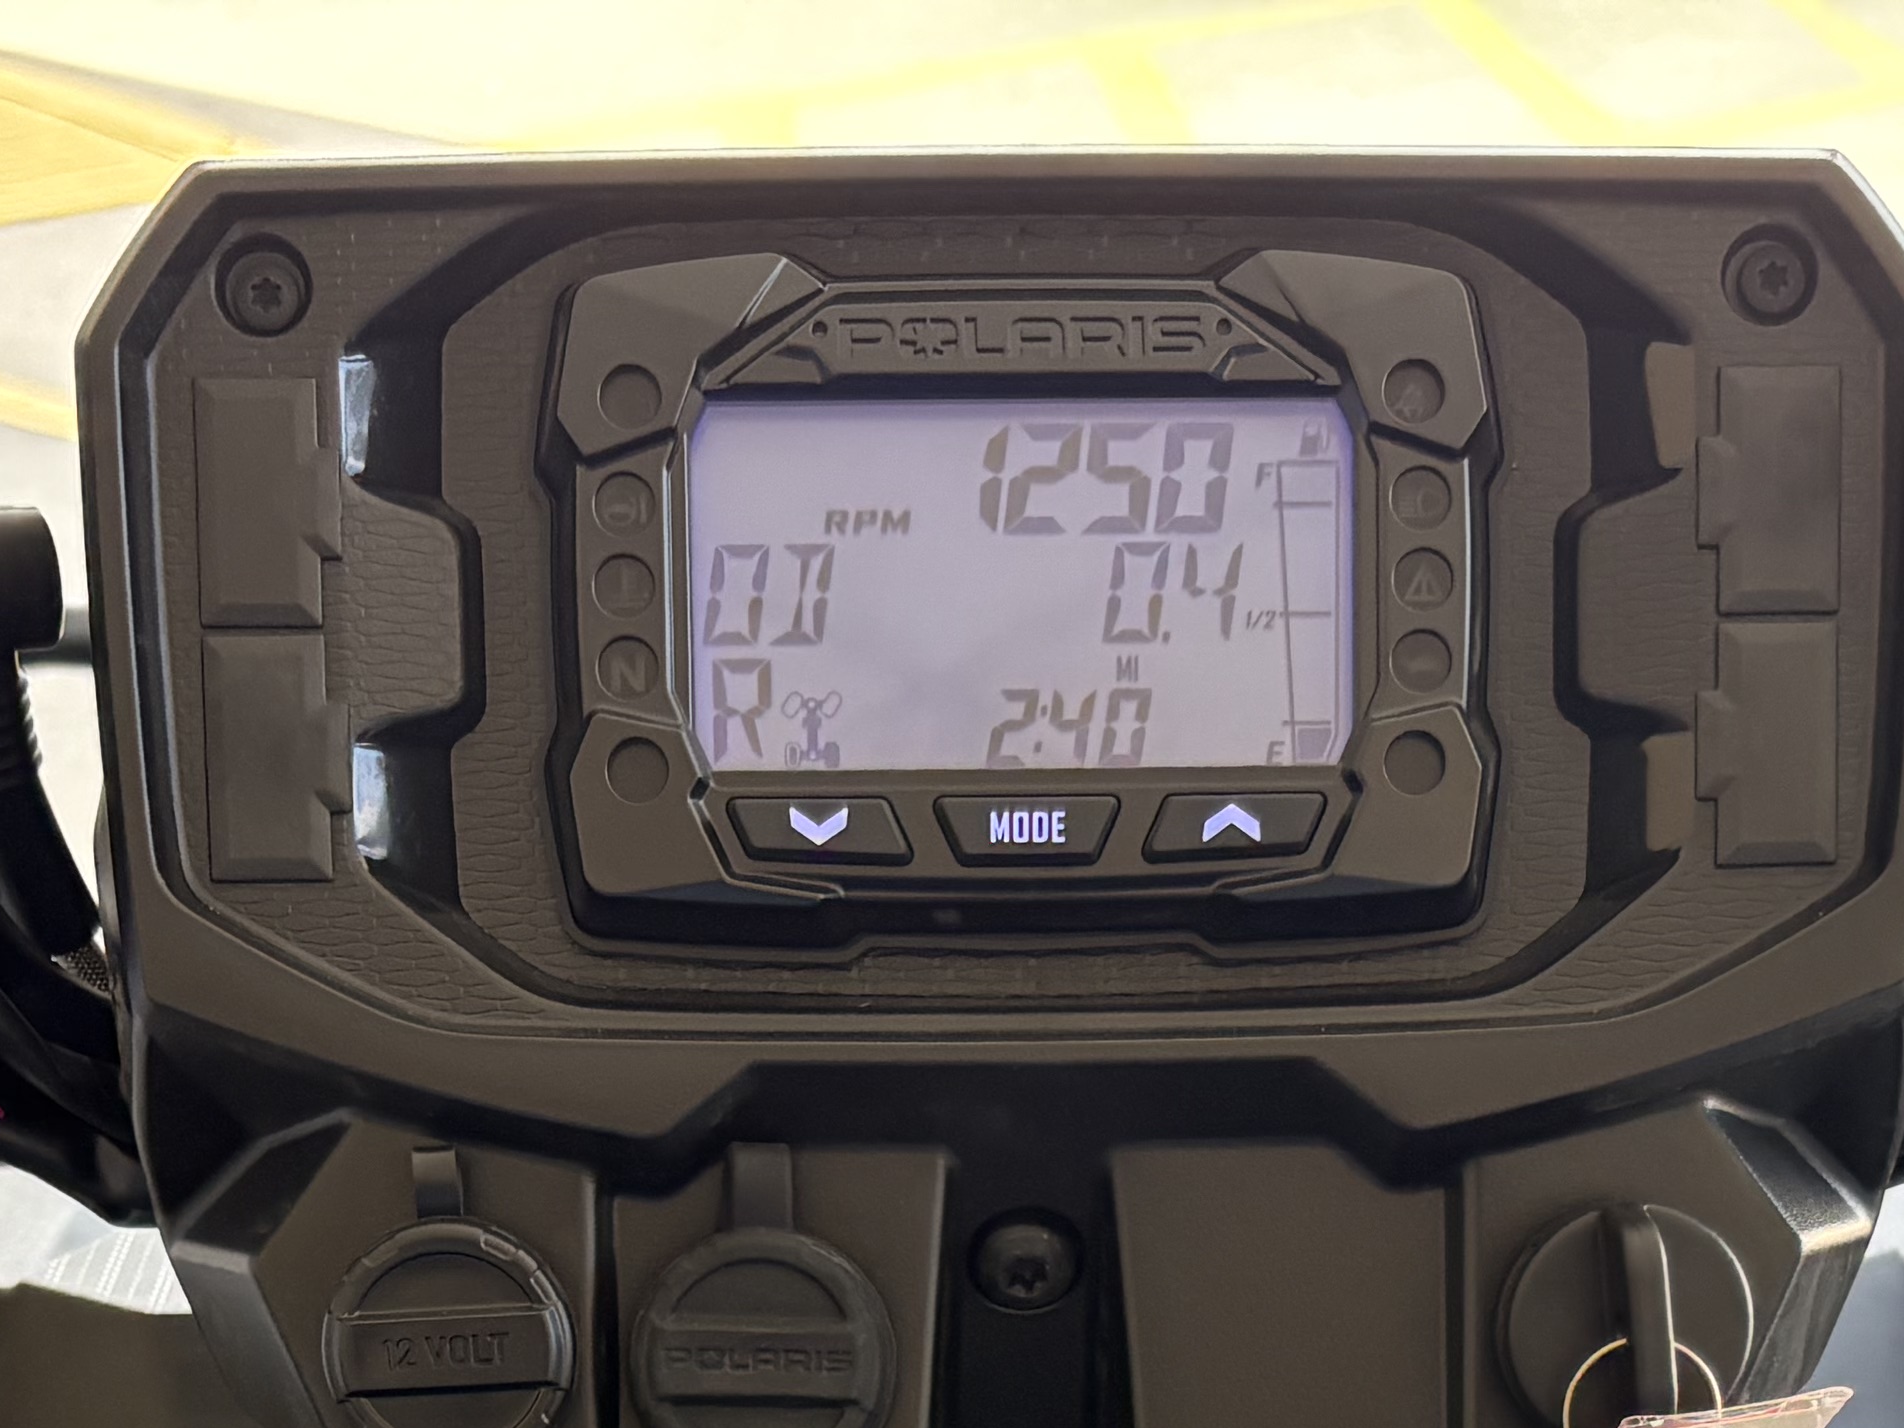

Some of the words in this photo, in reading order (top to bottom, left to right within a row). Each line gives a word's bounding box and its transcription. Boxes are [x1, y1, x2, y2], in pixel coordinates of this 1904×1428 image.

[838, 316, 1206, 358] POLARIS
[980, 422, 1234, 534] 1250
[824, 509, 911, 535] RPM
[1102, 541, 1244, 643] 0.4
[1246, 610, 1276, 631] 1/2
[1116, 655, 1139, 682] MI
[712, 658, 772, 765] R
[986, 688, 1152, 767] 2:40
[990, 810, 1066, 844] MODE
[382, 1336, 417, 1371] 12
[424, 1331, 513, 1368] VOLT
[663, 1344, 854, 1376] POLARIS
